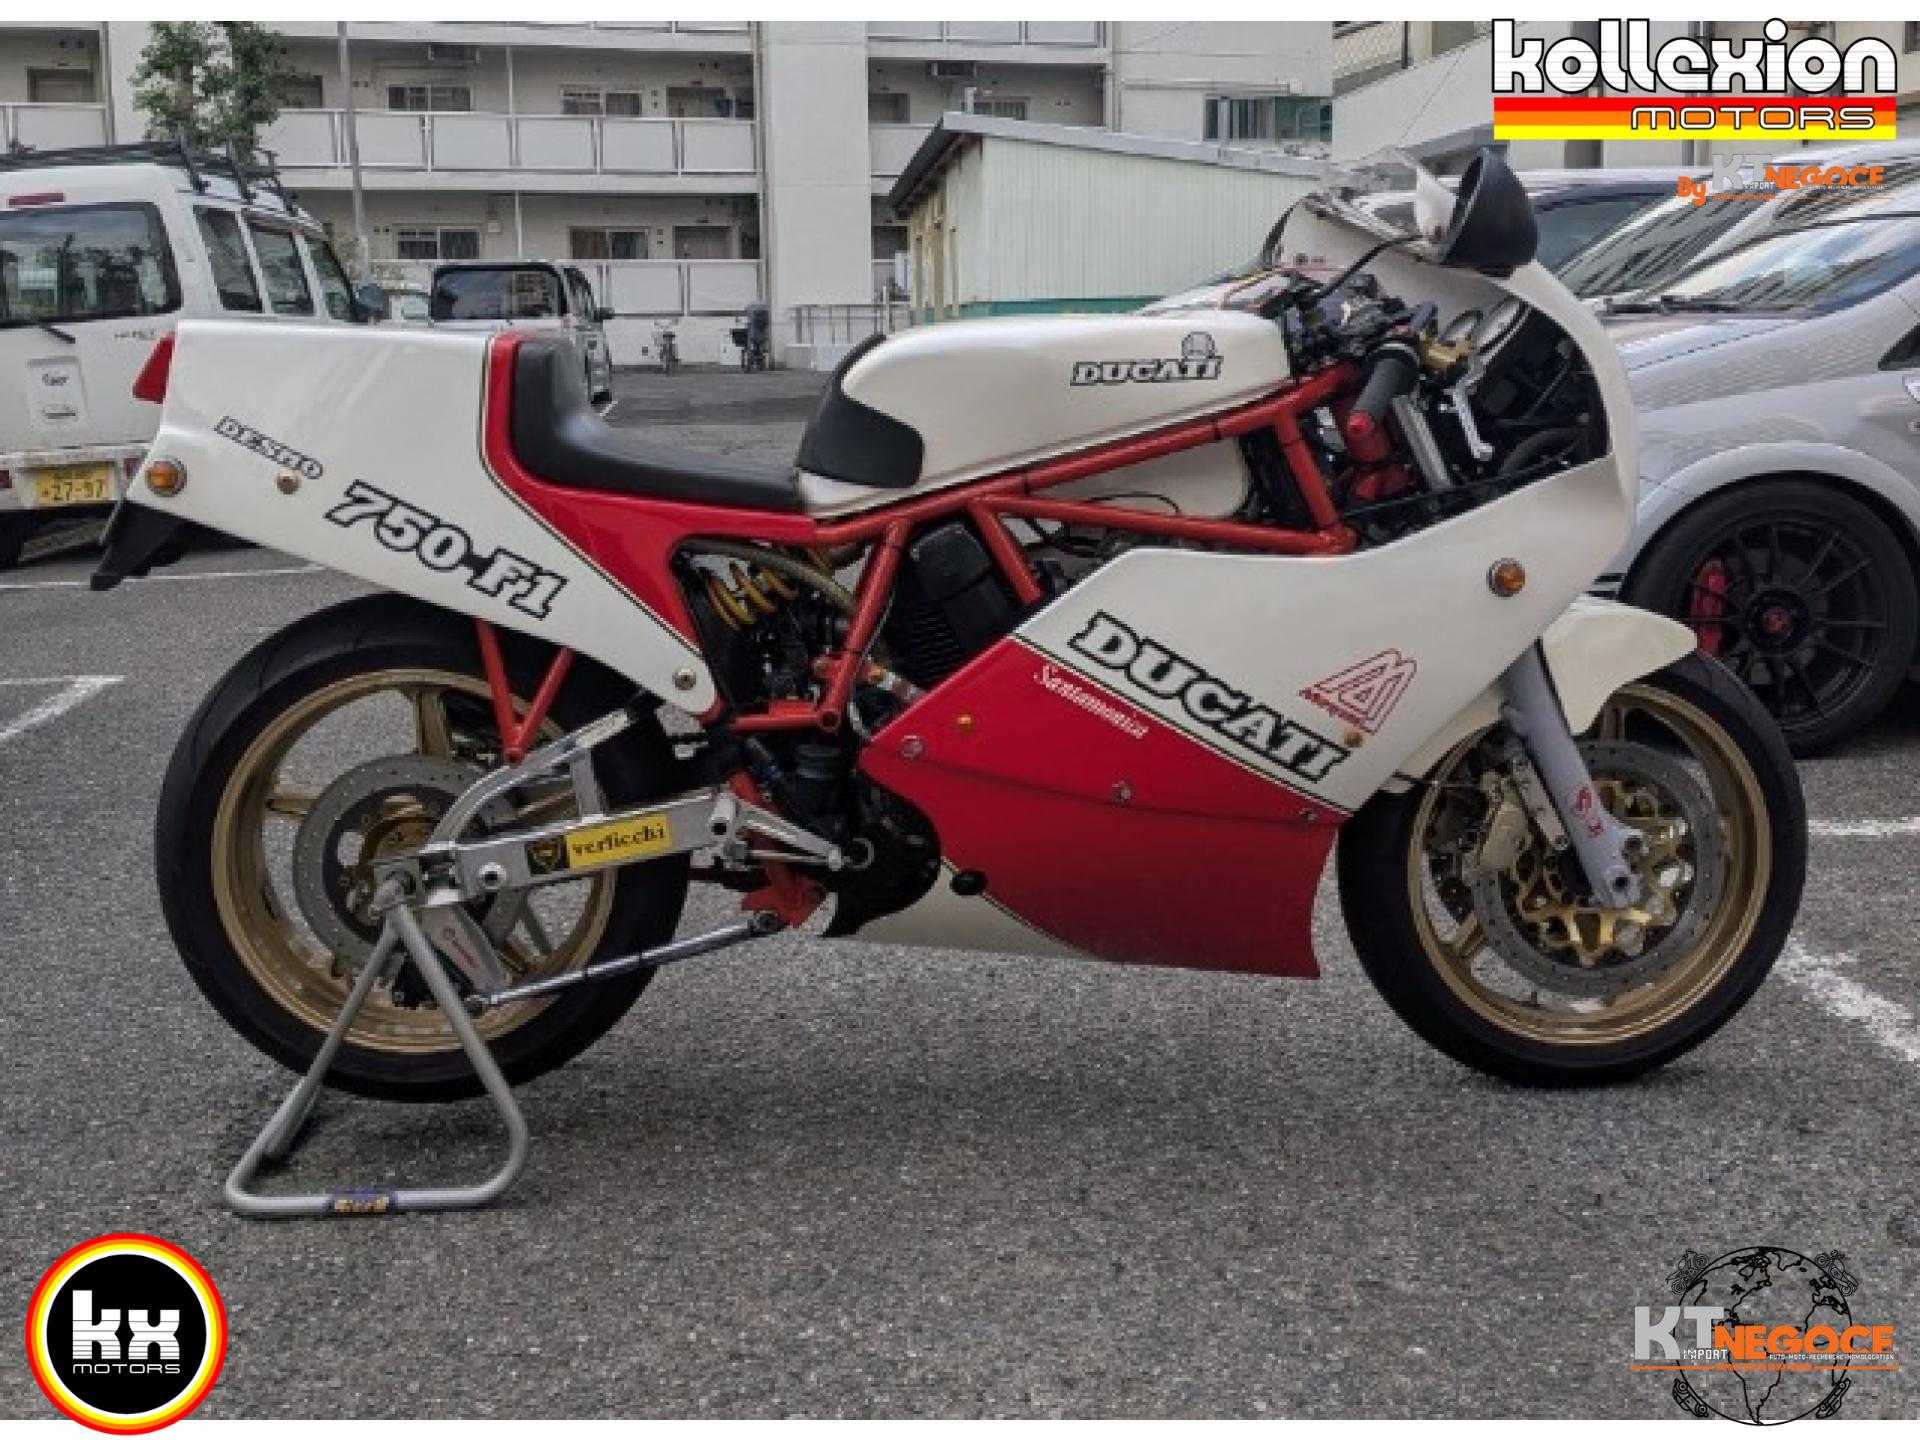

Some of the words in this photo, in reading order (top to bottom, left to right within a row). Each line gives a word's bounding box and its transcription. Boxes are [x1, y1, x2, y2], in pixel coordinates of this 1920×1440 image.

[1070, 355, 1225, 387] DUCATI
[213, 415, 323, 480] DESMO
[1066, 609, 1351, 784] DUCATI
